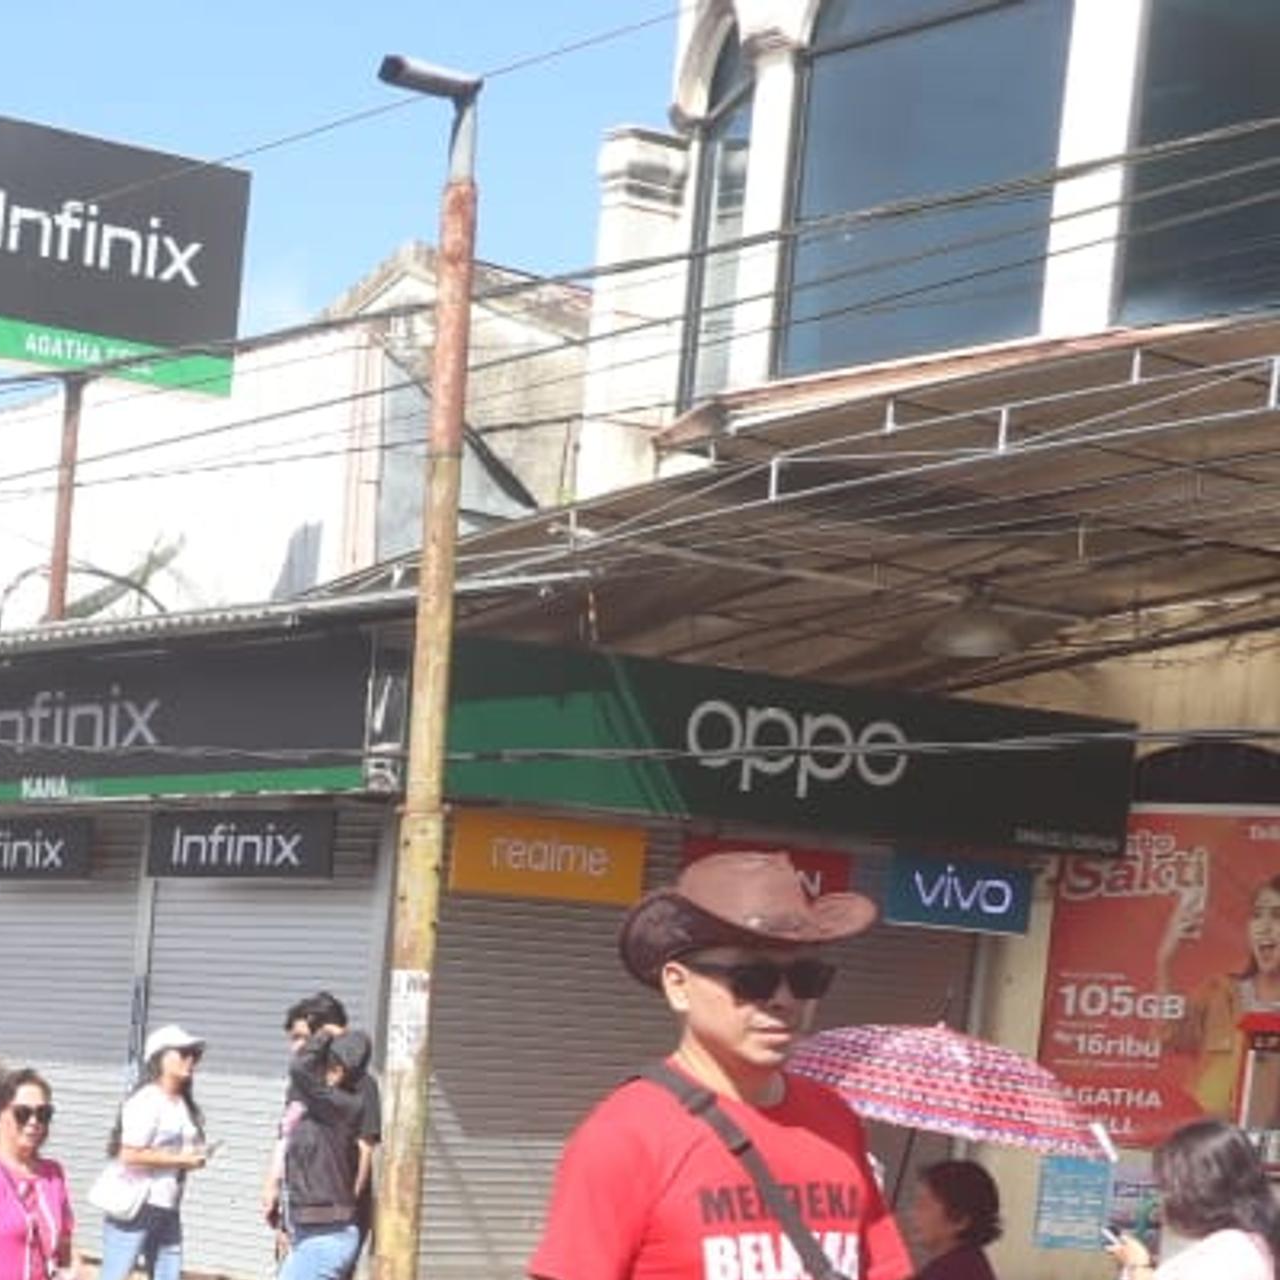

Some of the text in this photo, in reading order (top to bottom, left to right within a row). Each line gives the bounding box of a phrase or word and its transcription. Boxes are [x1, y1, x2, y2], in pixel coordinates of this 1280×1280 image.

[25, 331, 102, 364] AGATHA
[687, 700, 909, 799] oppo
[171, 823, 303, 867] Infinix
[489, 834, 612, 876] realme
[913, 864, 1013, 915] vivo
[1059, 984, 1186, 1020] 105GB
